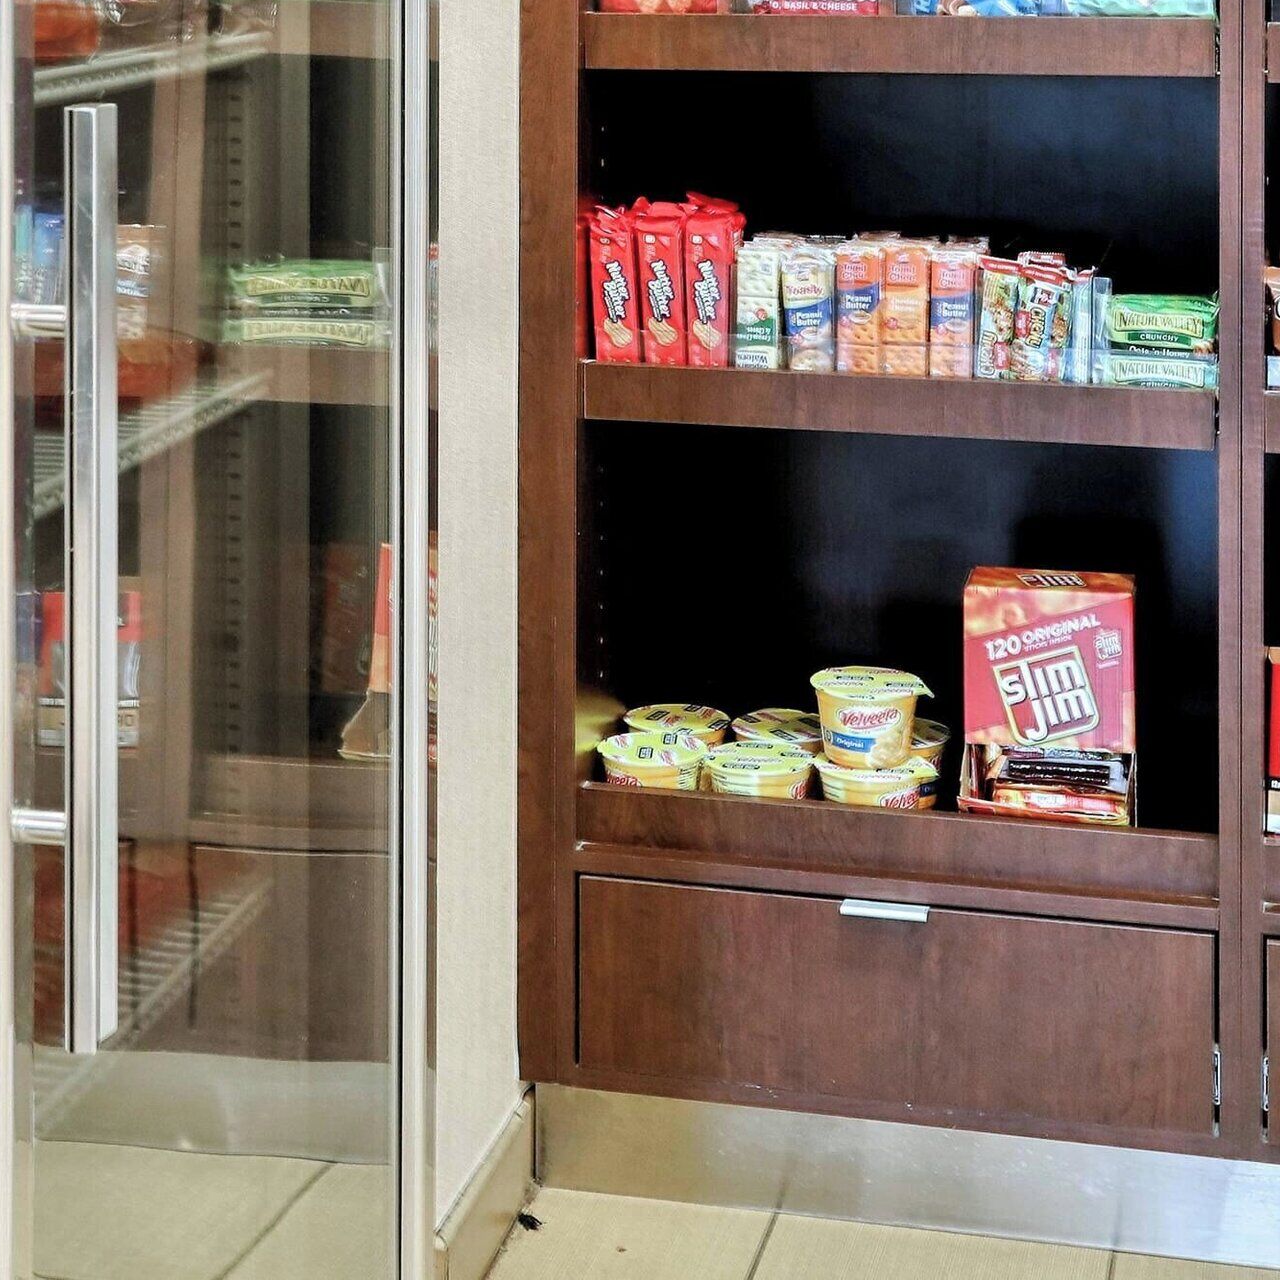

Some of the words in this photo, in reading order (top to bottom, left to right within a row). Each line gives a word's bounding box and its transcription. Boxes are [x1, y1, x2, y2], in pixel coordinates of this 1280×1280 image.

[784, 1, 810, 10] BASIL
[821, 2, 857, 11] CHEESE
[605, 260, 630, 300] Nutter
[650, 260, 675, 300] Nutter
[697, 260, 721, 300] Nutter
[603, 281, 626, 318] Butter
[647, 281, 671, 318] Butter
[694, 281, 716, 319] Butter
[846, 294, 872, 303] Peanut
[846, 302, 870, 310] Butter
[942, 302, 970, 311] Peanut
[796, 311, 823, 320] Peanut
[796, 318, 821, 326] Butter
[942, 309, 968, 318] Butter
[1119, 311, 1161, 327] NATURE
[1161, 316, 1201, 334] VALLEY
[1140, 333, 1179, 342] CRUNCHY
[1129, 346, 1149, 355] Oats
[1162, 347, 1191, 358] Honey
[1119, 361, 1160, 376] NATURE
[1161, 364, 1200, 384] VALLEY
[986, 637, 1022, 661] 120
[1022, 613, 1102, 646] ORIGINAL
[841, 707, 899, 728] Velveeta
[835, 736, 865, 749] Original
